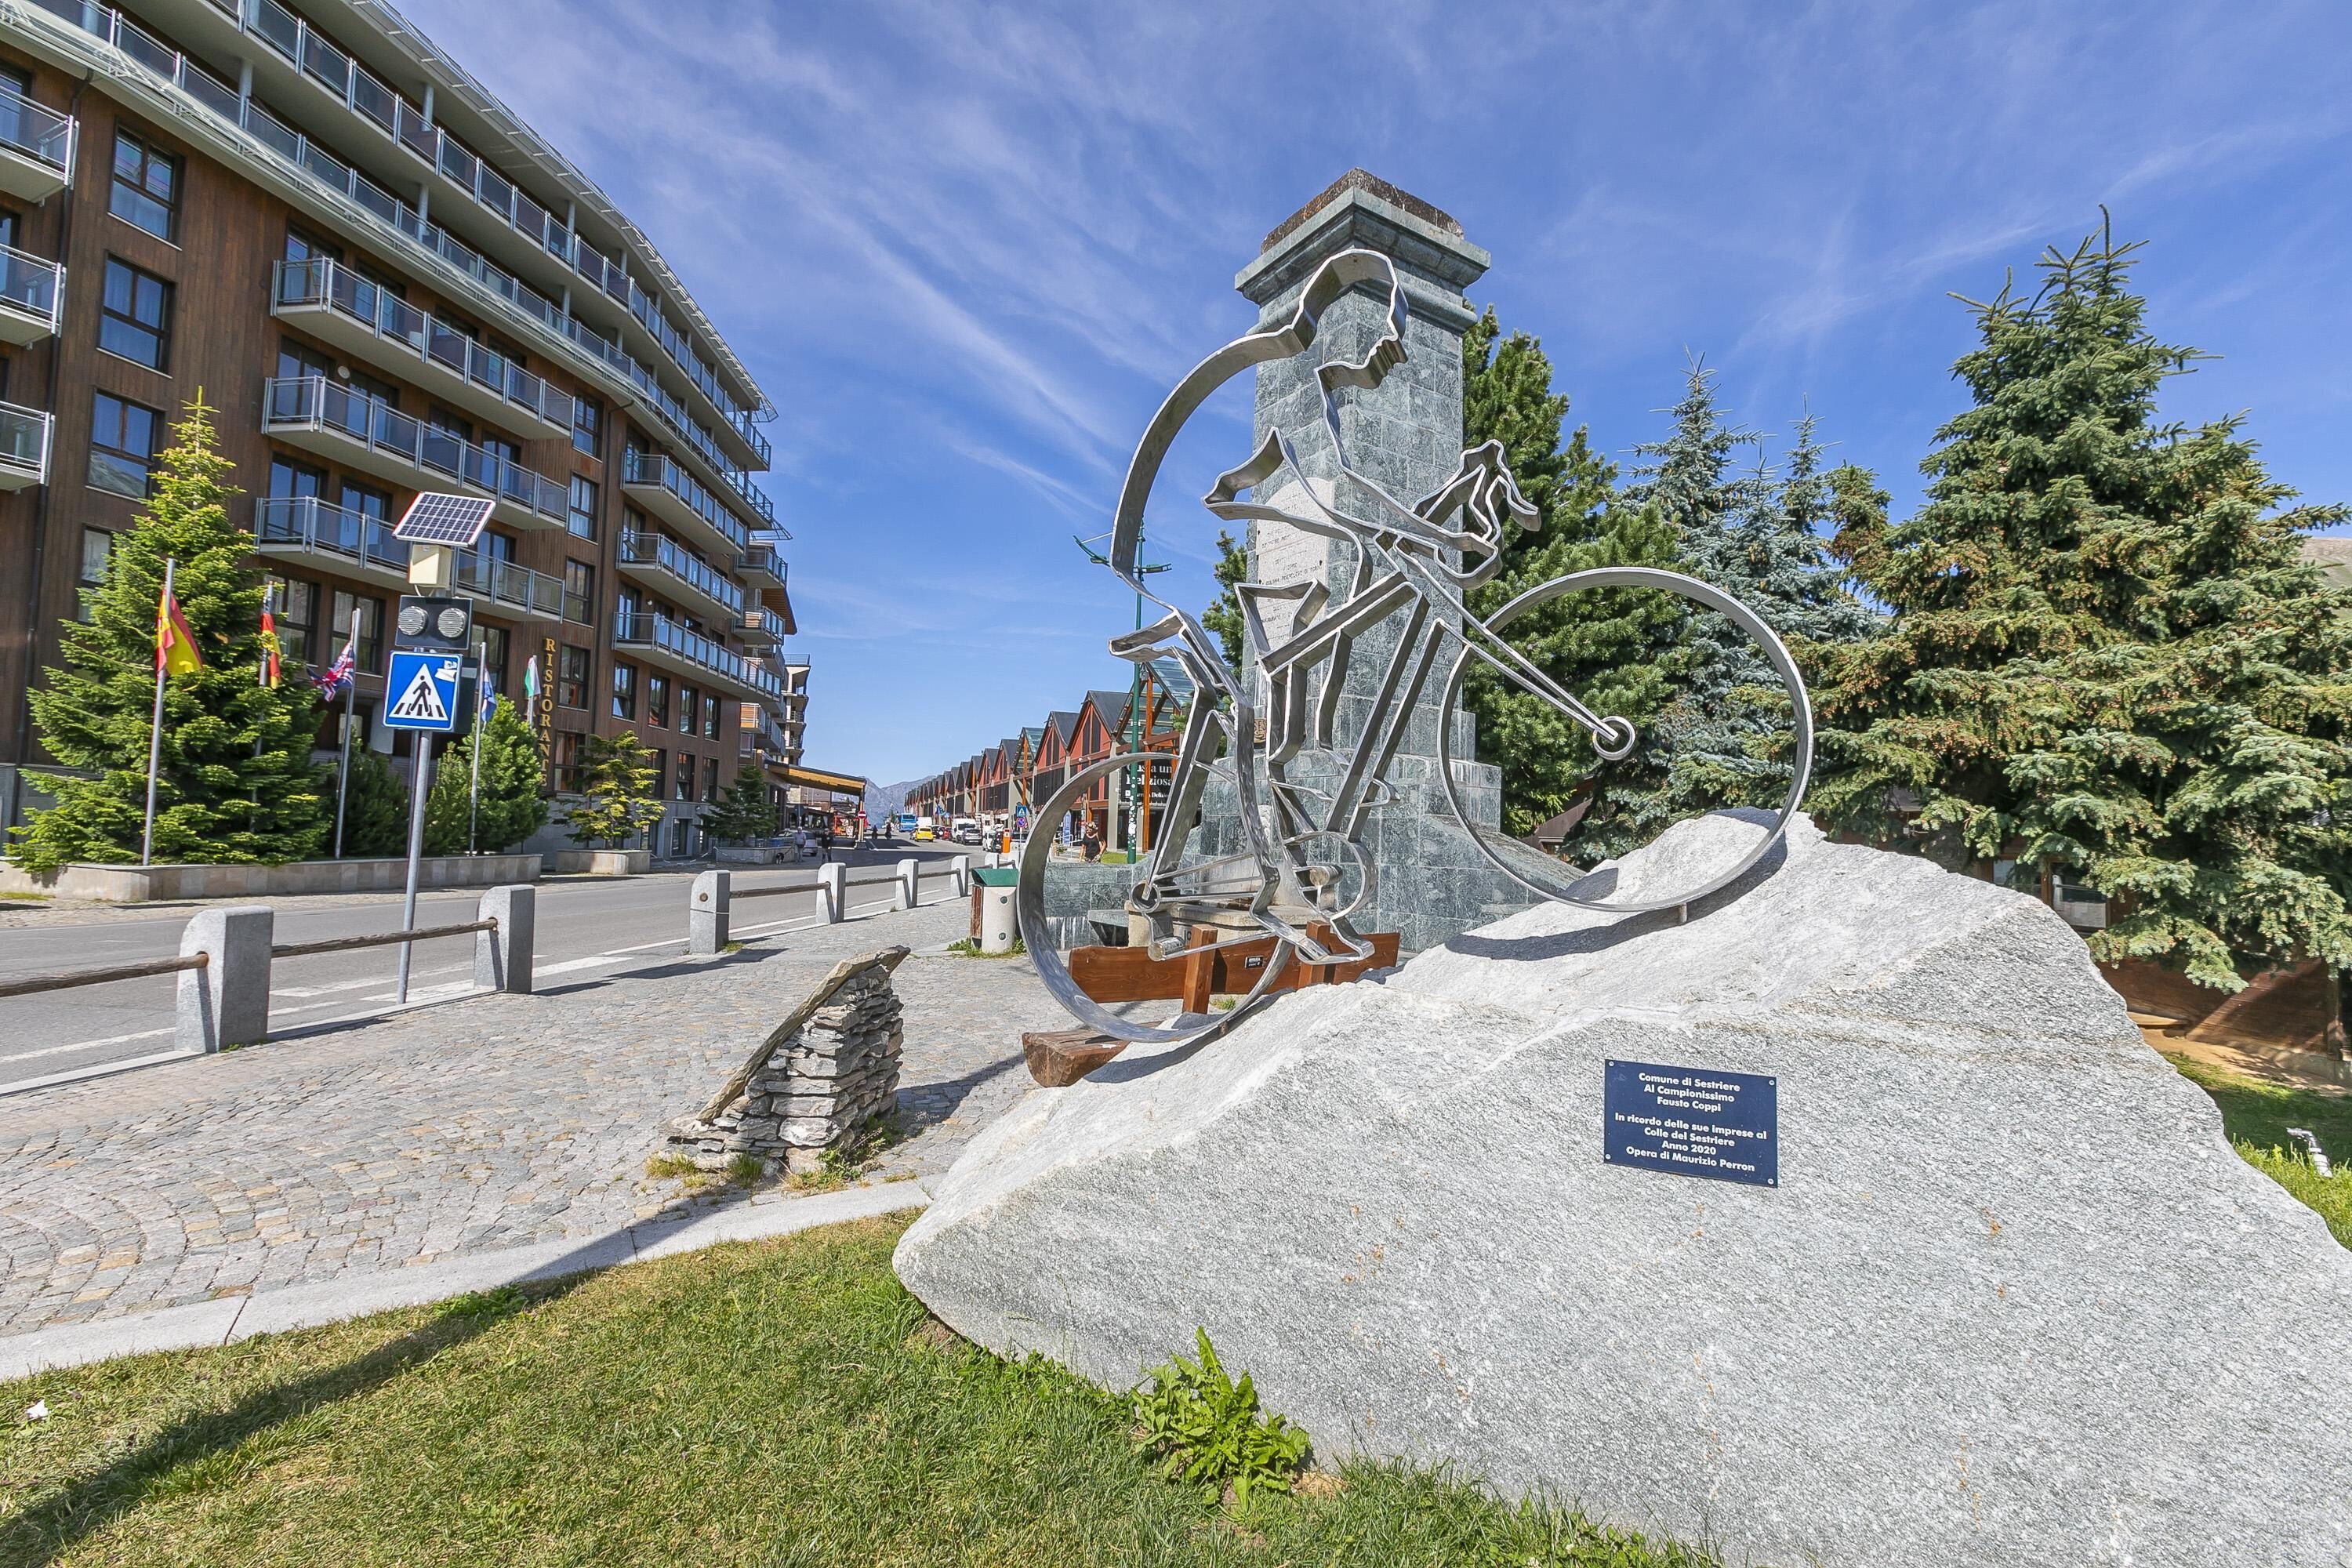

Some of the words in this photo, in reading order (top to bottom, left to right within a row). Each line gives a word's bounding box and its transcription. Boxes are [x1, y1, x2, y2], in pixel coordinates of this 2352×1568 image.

[539, 637, 556, 786] RISTORANTE
[1126, 774, 1172, 786] elziosa
[1639, 1073, 1679, 1084] Comune
[1682, 1077, 1691, 1086] di
[1694, 1079, 1740, 1091] Sestriere
[1644, 1084, 1654, 1093] Al
[1657, 1086, 1734, 1102] Campionissimo
[1657, 1096, 1690, 1108] Fausto
[1692, 1101, 1721, 1112] Coppi
[1615, 1112, 1624, 1121] In
[1628, 1114, 1661, 1126] ricordo
[1664, 1119, 1689, 1129] delle
[1712, 1125, 1754, 1138] imprese
[1756, 1131, 1766, 1139] al
[1644, 1127, 1668, 1138] Colle
[1671, 1131, 1687, 1140] del
[1690, 1133, 1735, 1146] Sestriere
[1662, 1141, 1689, 1151] Anno
[1691, 1145, 1716, 1155] 2020
[1626, 1146, 1657, 1158] Opera
[1660, 1151, 1669, 1160] di
[1672, 1152, 1717, 1166] Maurizio
[1720, 1159, 1755, 1171] Perron
